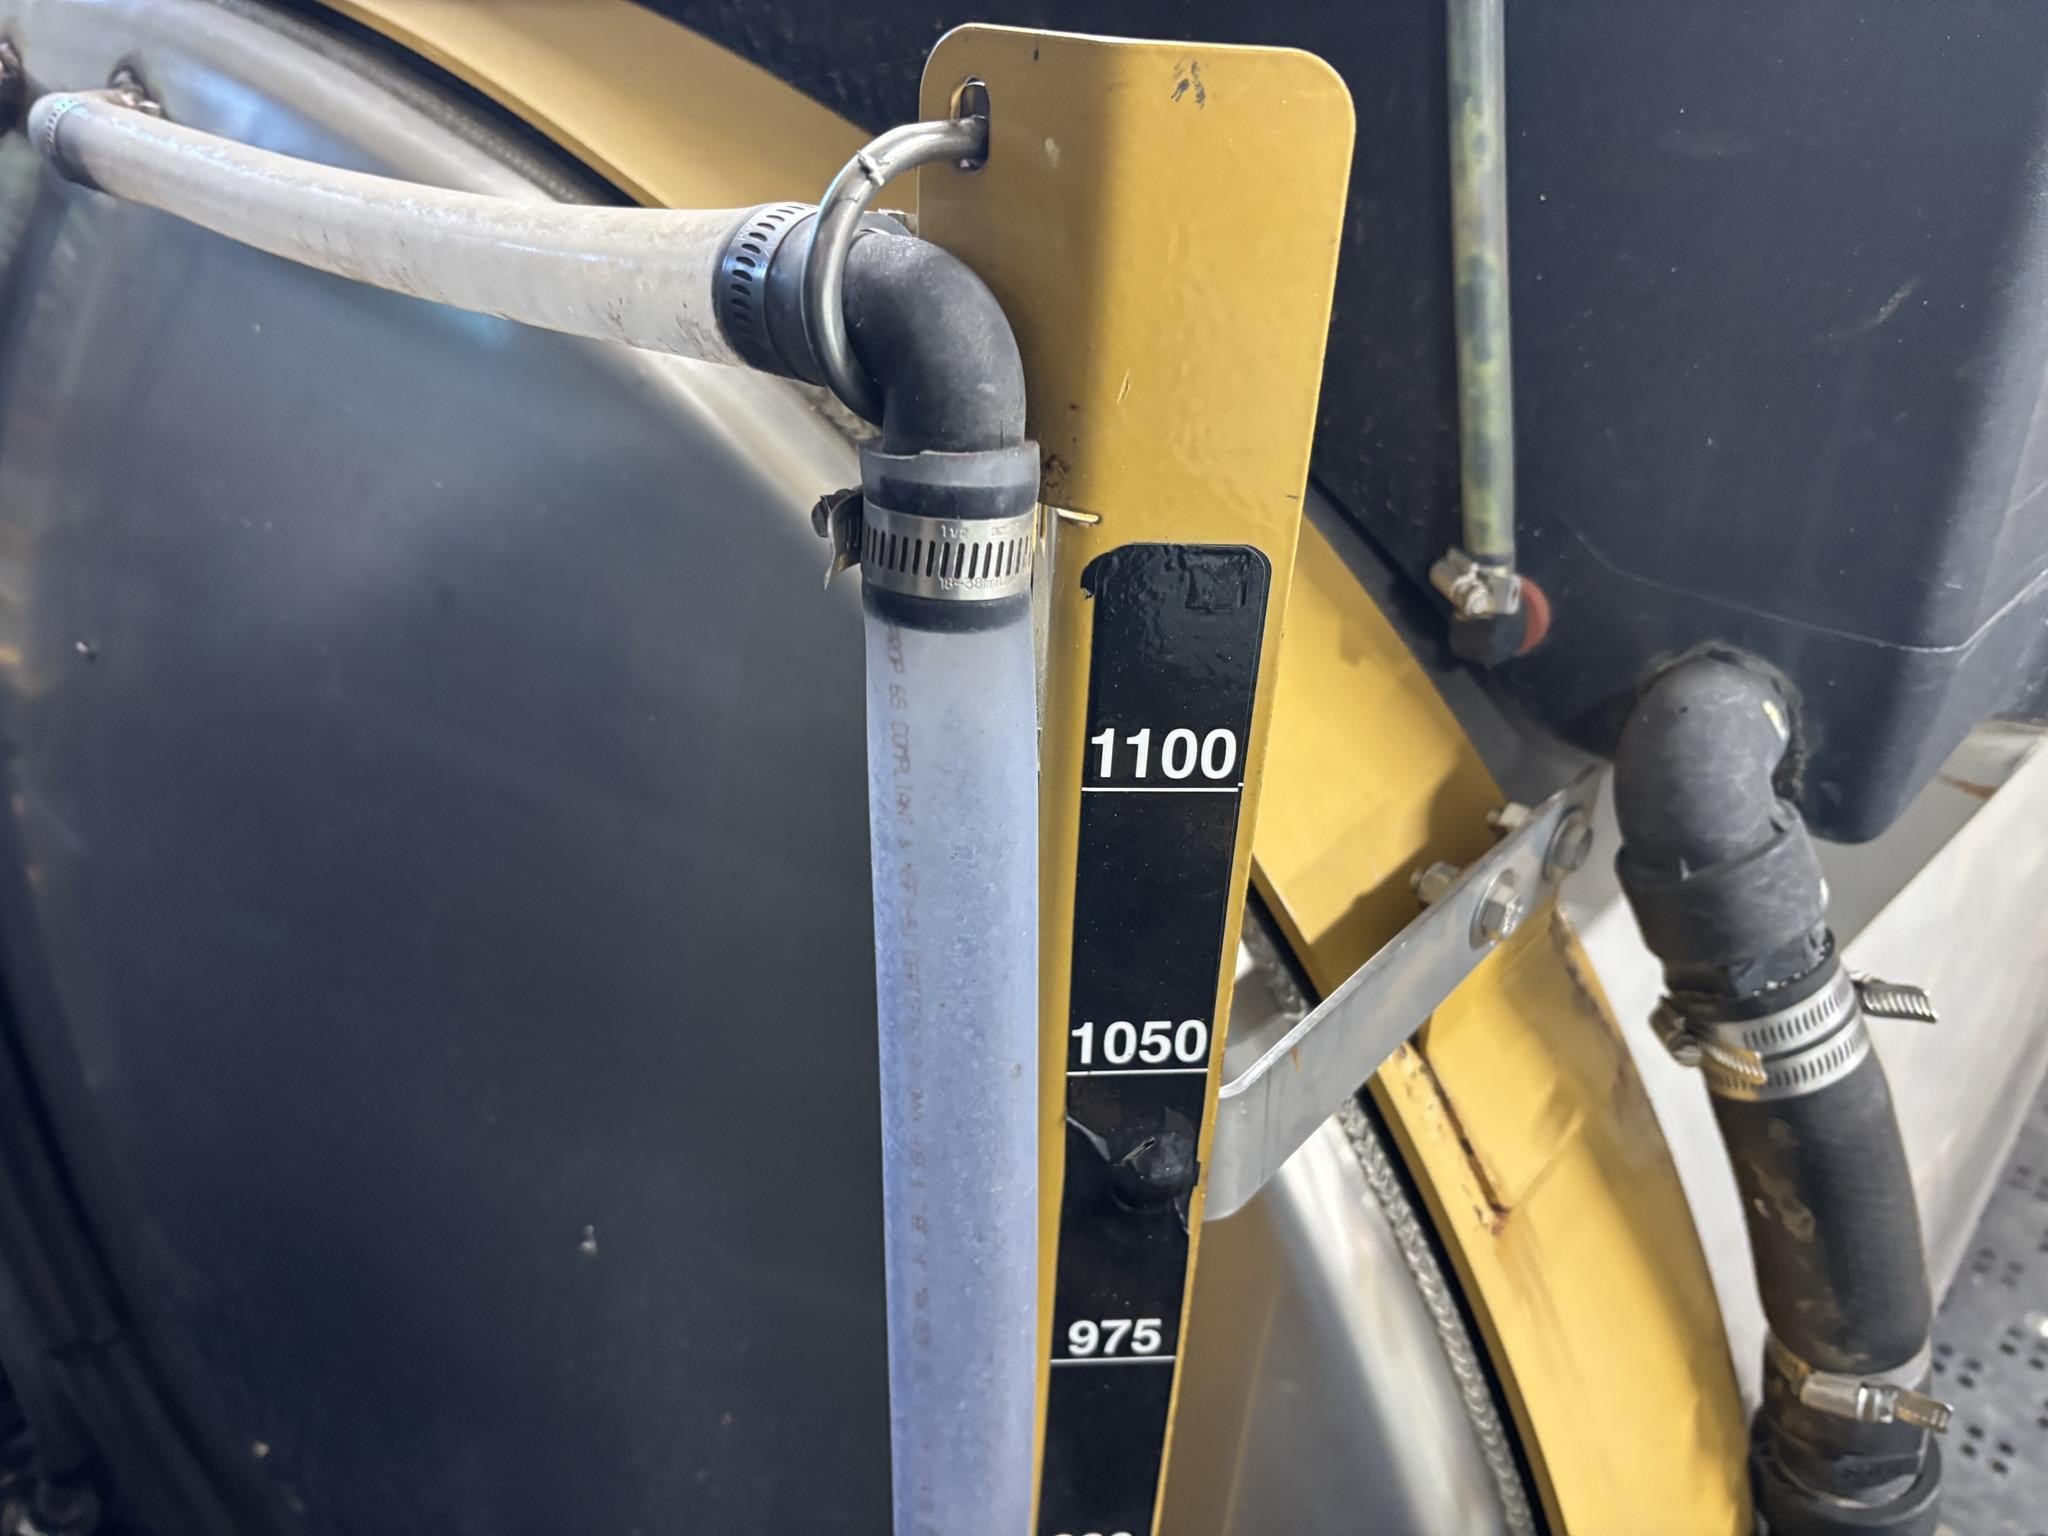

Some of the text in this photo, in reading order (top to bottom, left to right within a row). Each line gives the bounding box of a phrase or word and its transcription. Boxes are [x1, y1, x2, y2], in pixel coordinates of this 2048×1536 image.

[1091, 728, 1237, 779] 1100
[1071, 1019, 1208, 1066] 1050
[1068, 1318, 1163, 1356] 975
